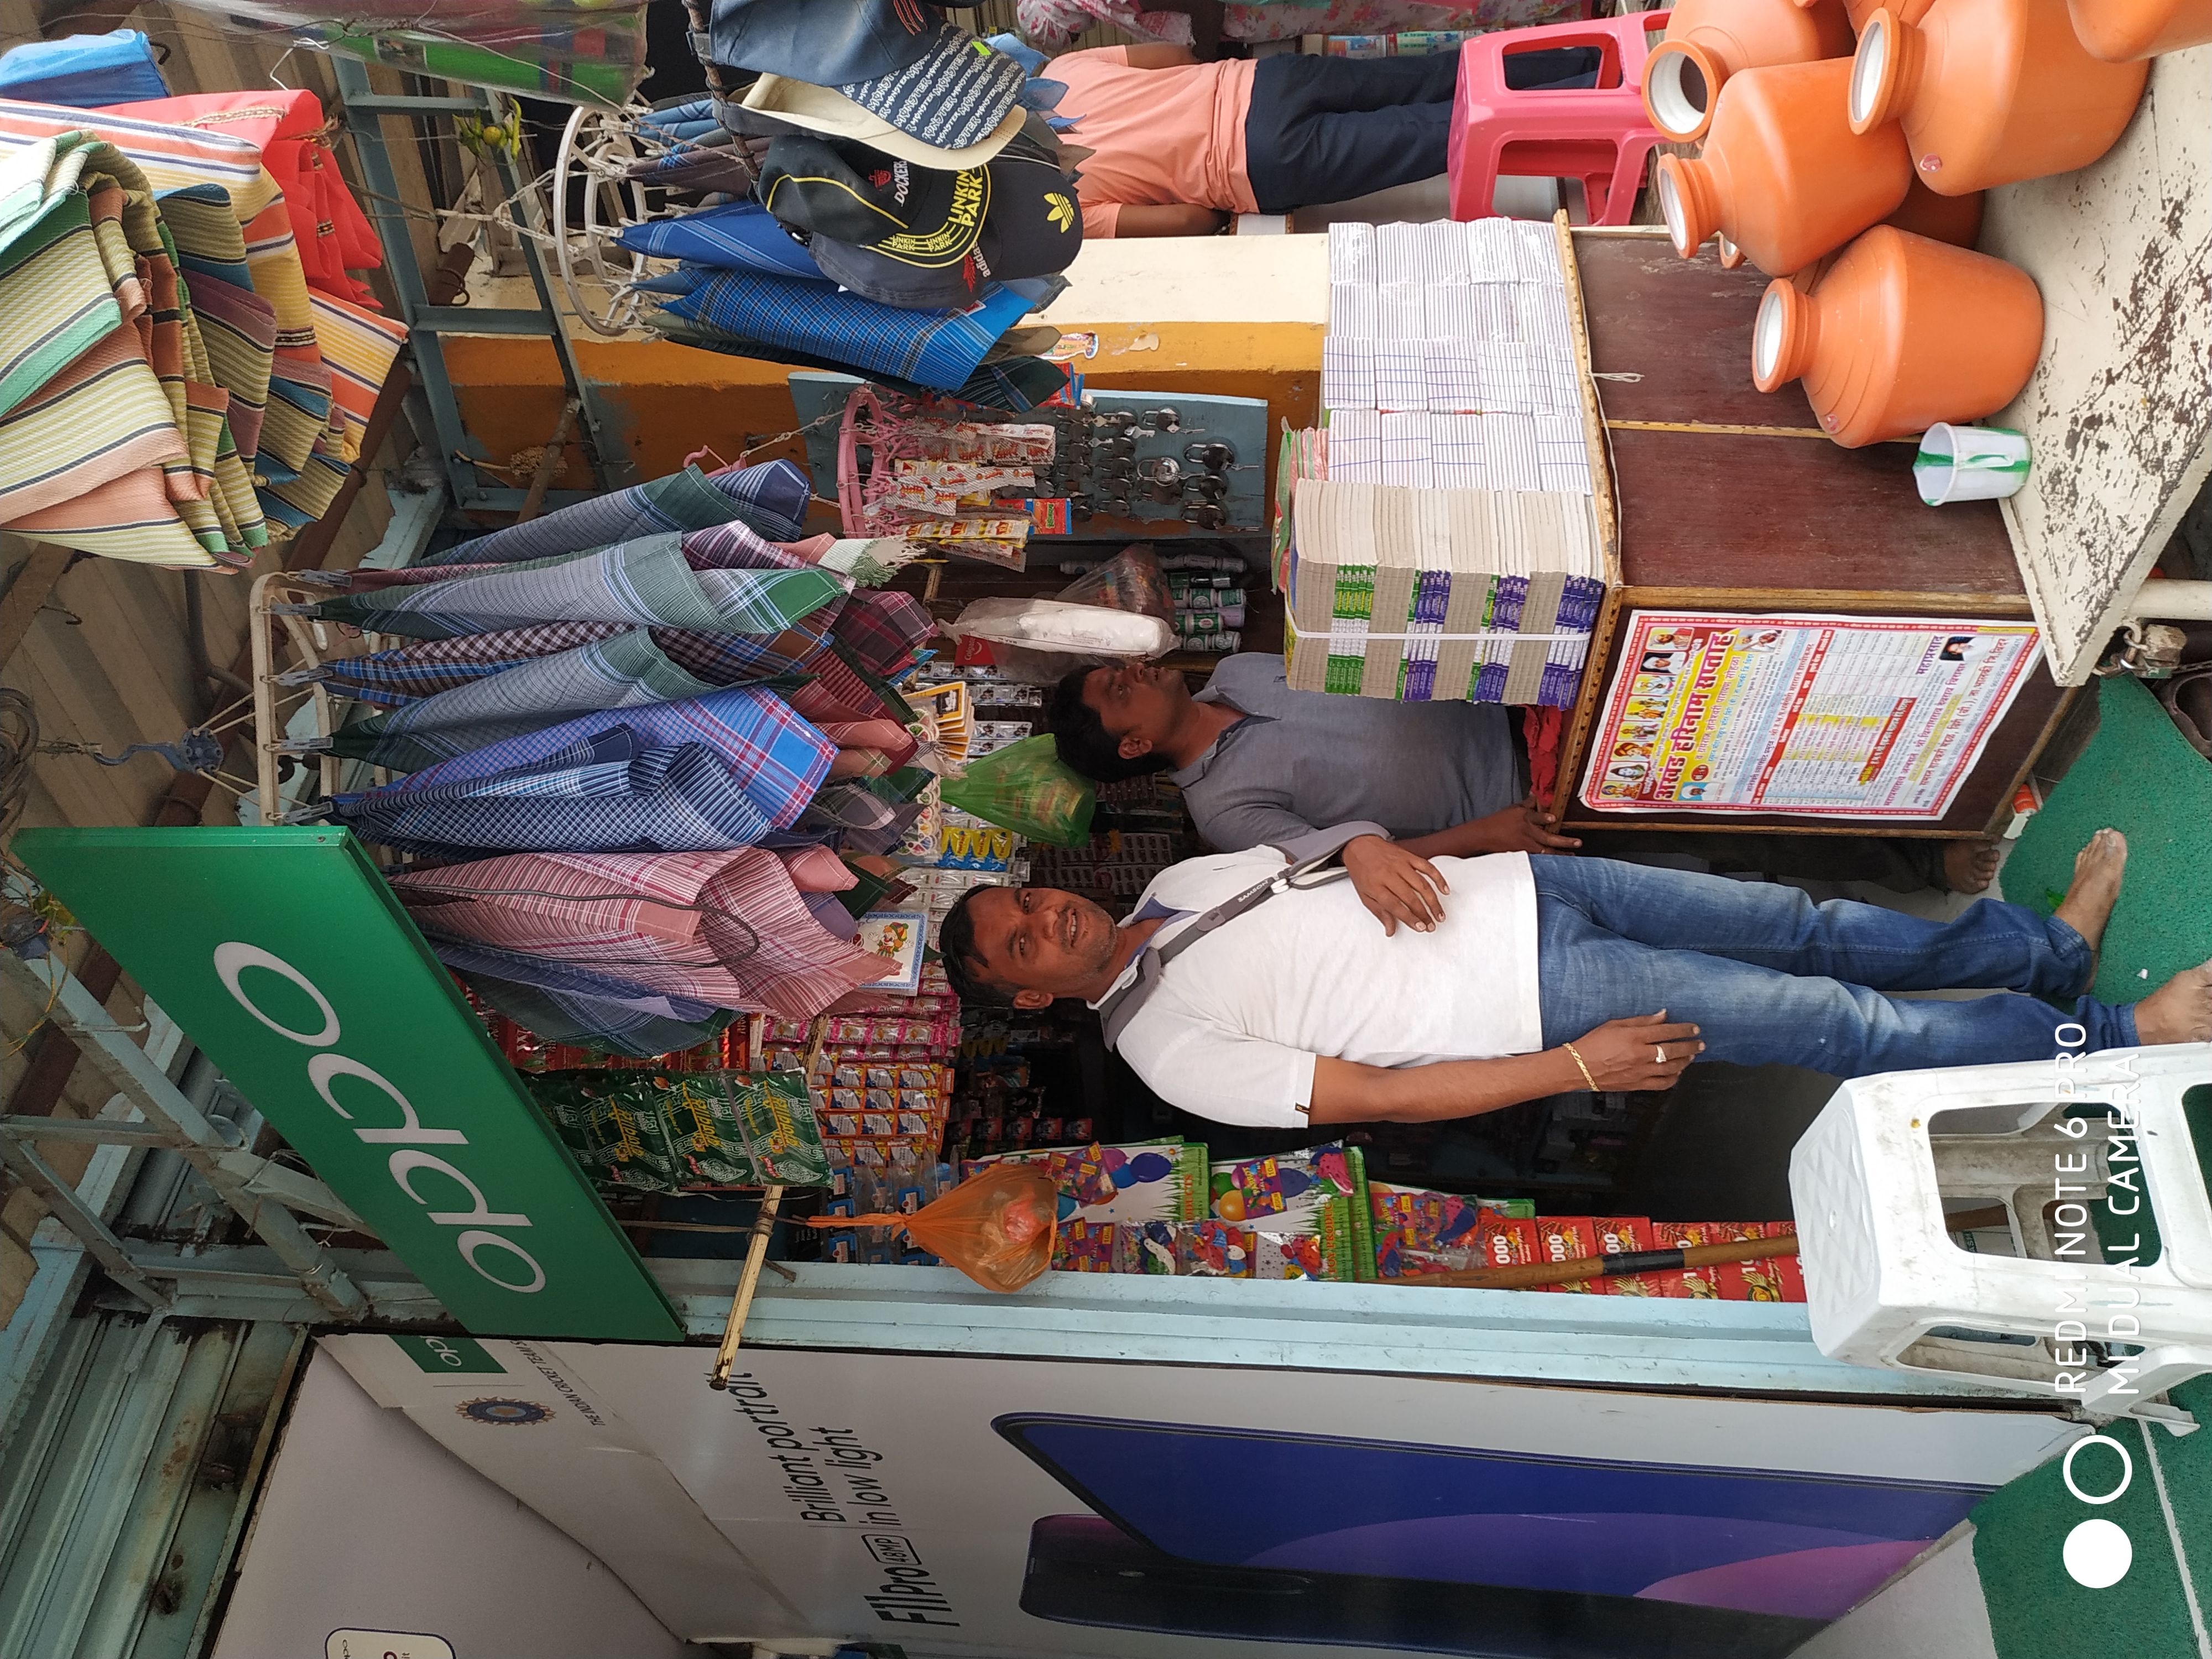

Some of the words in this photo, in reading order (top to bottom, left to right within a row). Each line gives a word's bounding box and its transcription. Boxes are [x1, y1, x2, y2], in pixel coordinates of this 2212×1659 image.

[947, 169, 969, 223] LINKIN
[961, 173, 983, 227] PARK
[892, 242, 915, 250] PARK
[893, 234, 916, 243] LINKIN
[926, 232, 950, 247] LINKIN
[928, 239, 952, 252] PARK
[972, 241, 991, 278] adidas
[1693, 633, 1735, 688] सप्ताह
[1916, 635, 1944, 675] महाप्रसाद
[1670, 692, 1709, 752] हरिनाम
[1655, 755, 1686, 799] अखंड
[1243, 1167, 1260, 1195] PARROT
[1324, 1202, 1334, 1249] PRODUC
[1379, 1198, 1394, 1225] PARROT
[1493, 1234, 1510, 1268] 000
[420, 1336, 462, 1366] op
[515, 1346, 546, 1365] TEAM
[536, 1366, 573, 1393] CRICKET
[567, 1393, 597, 1414] INDIAN
[703, 1373, 819, 1452] portrait
[586, 1415, 606, 1426] THE
[808, 1427, 883, 1469] light
[768, 1455, 846, 1522] Brilliant
[844, 1474, 891, 1506] low
[859, 1512, 901, 1526] in
[875, 1537, 910, 1563] 48MP
